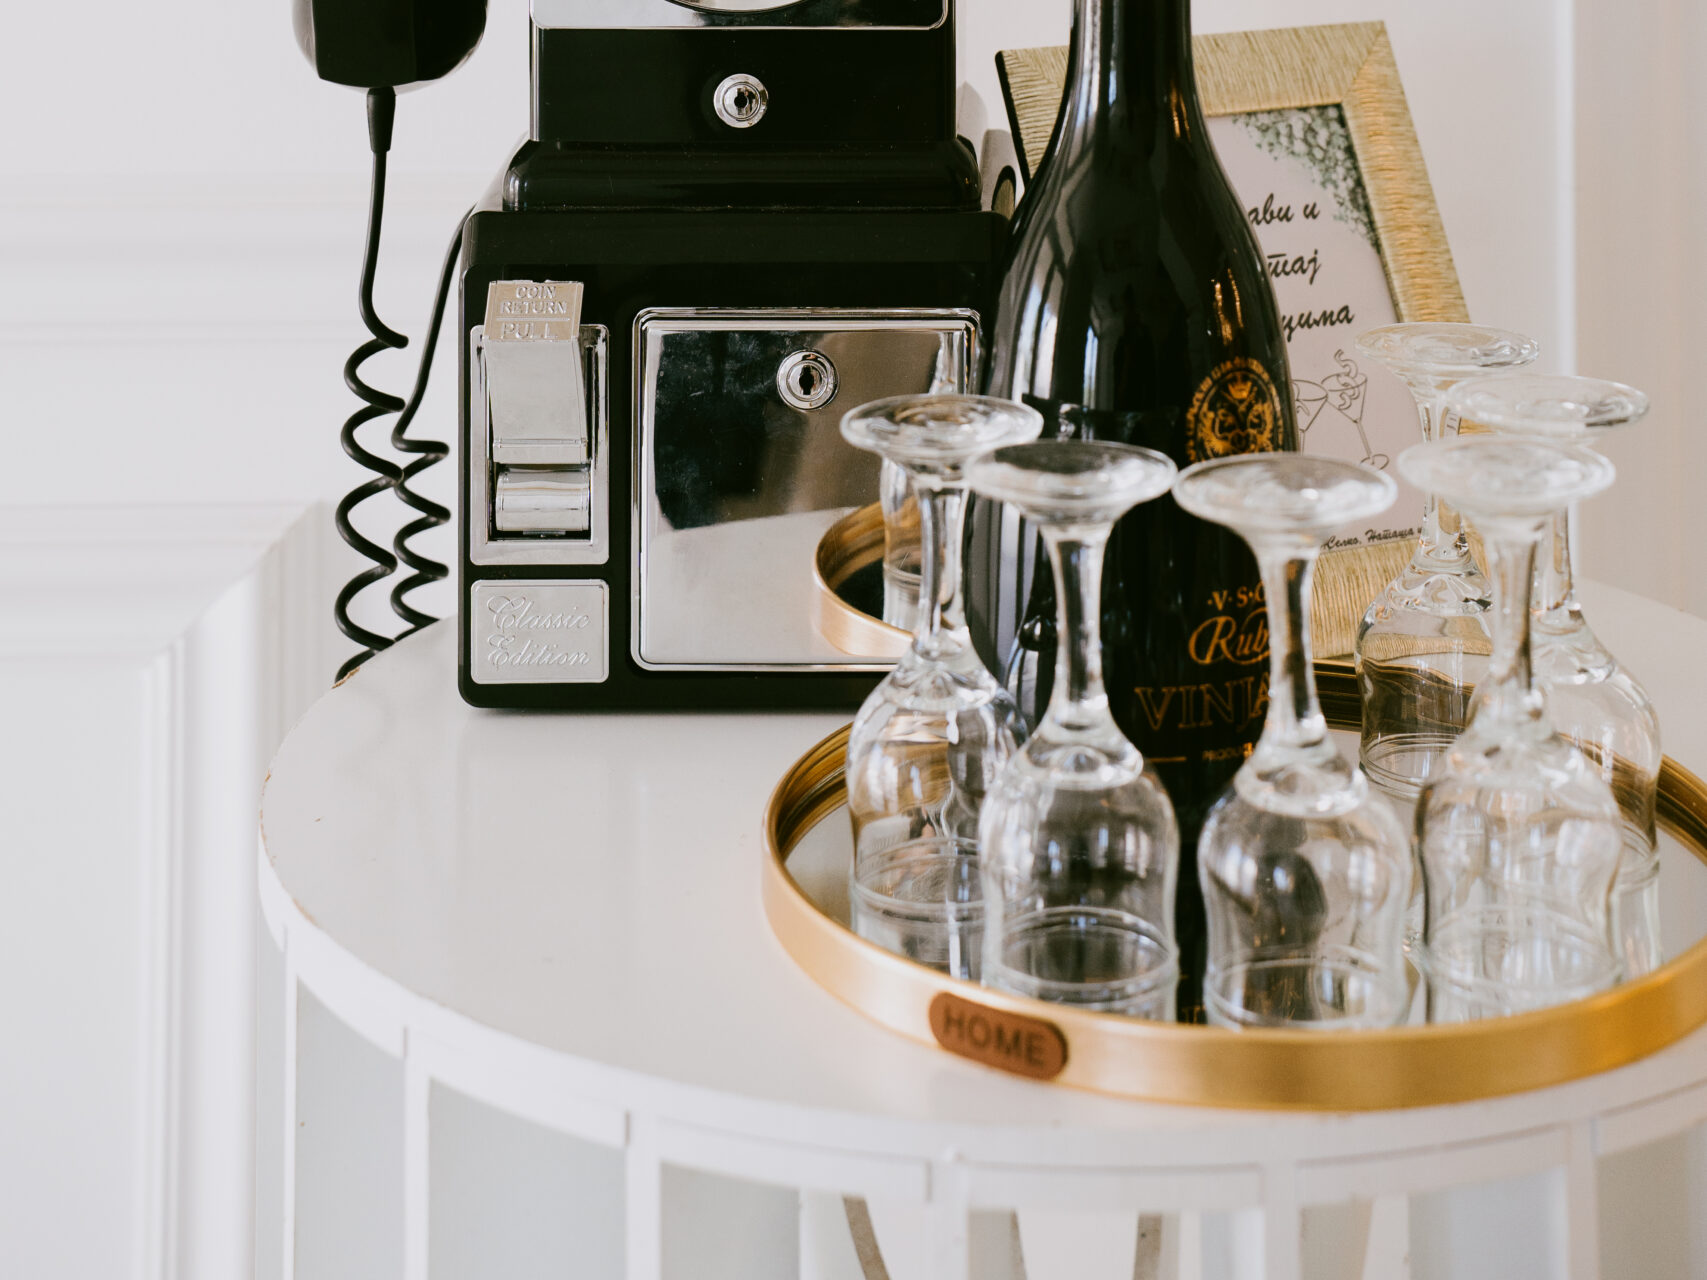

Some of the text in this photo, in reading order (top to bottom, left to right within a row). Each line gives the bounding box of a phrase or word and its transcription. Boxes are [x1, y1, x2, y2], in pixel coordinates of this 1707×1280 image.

[515, 285, 557, 299] COIN
[501, 300, 568, 314] RETURN
[500, 322, 559, 340] PULL
[487, 595, 591, 634] Classic
[487, 634, 591, 672] Edition
[943, 1006, 1045, 1067] HOME
